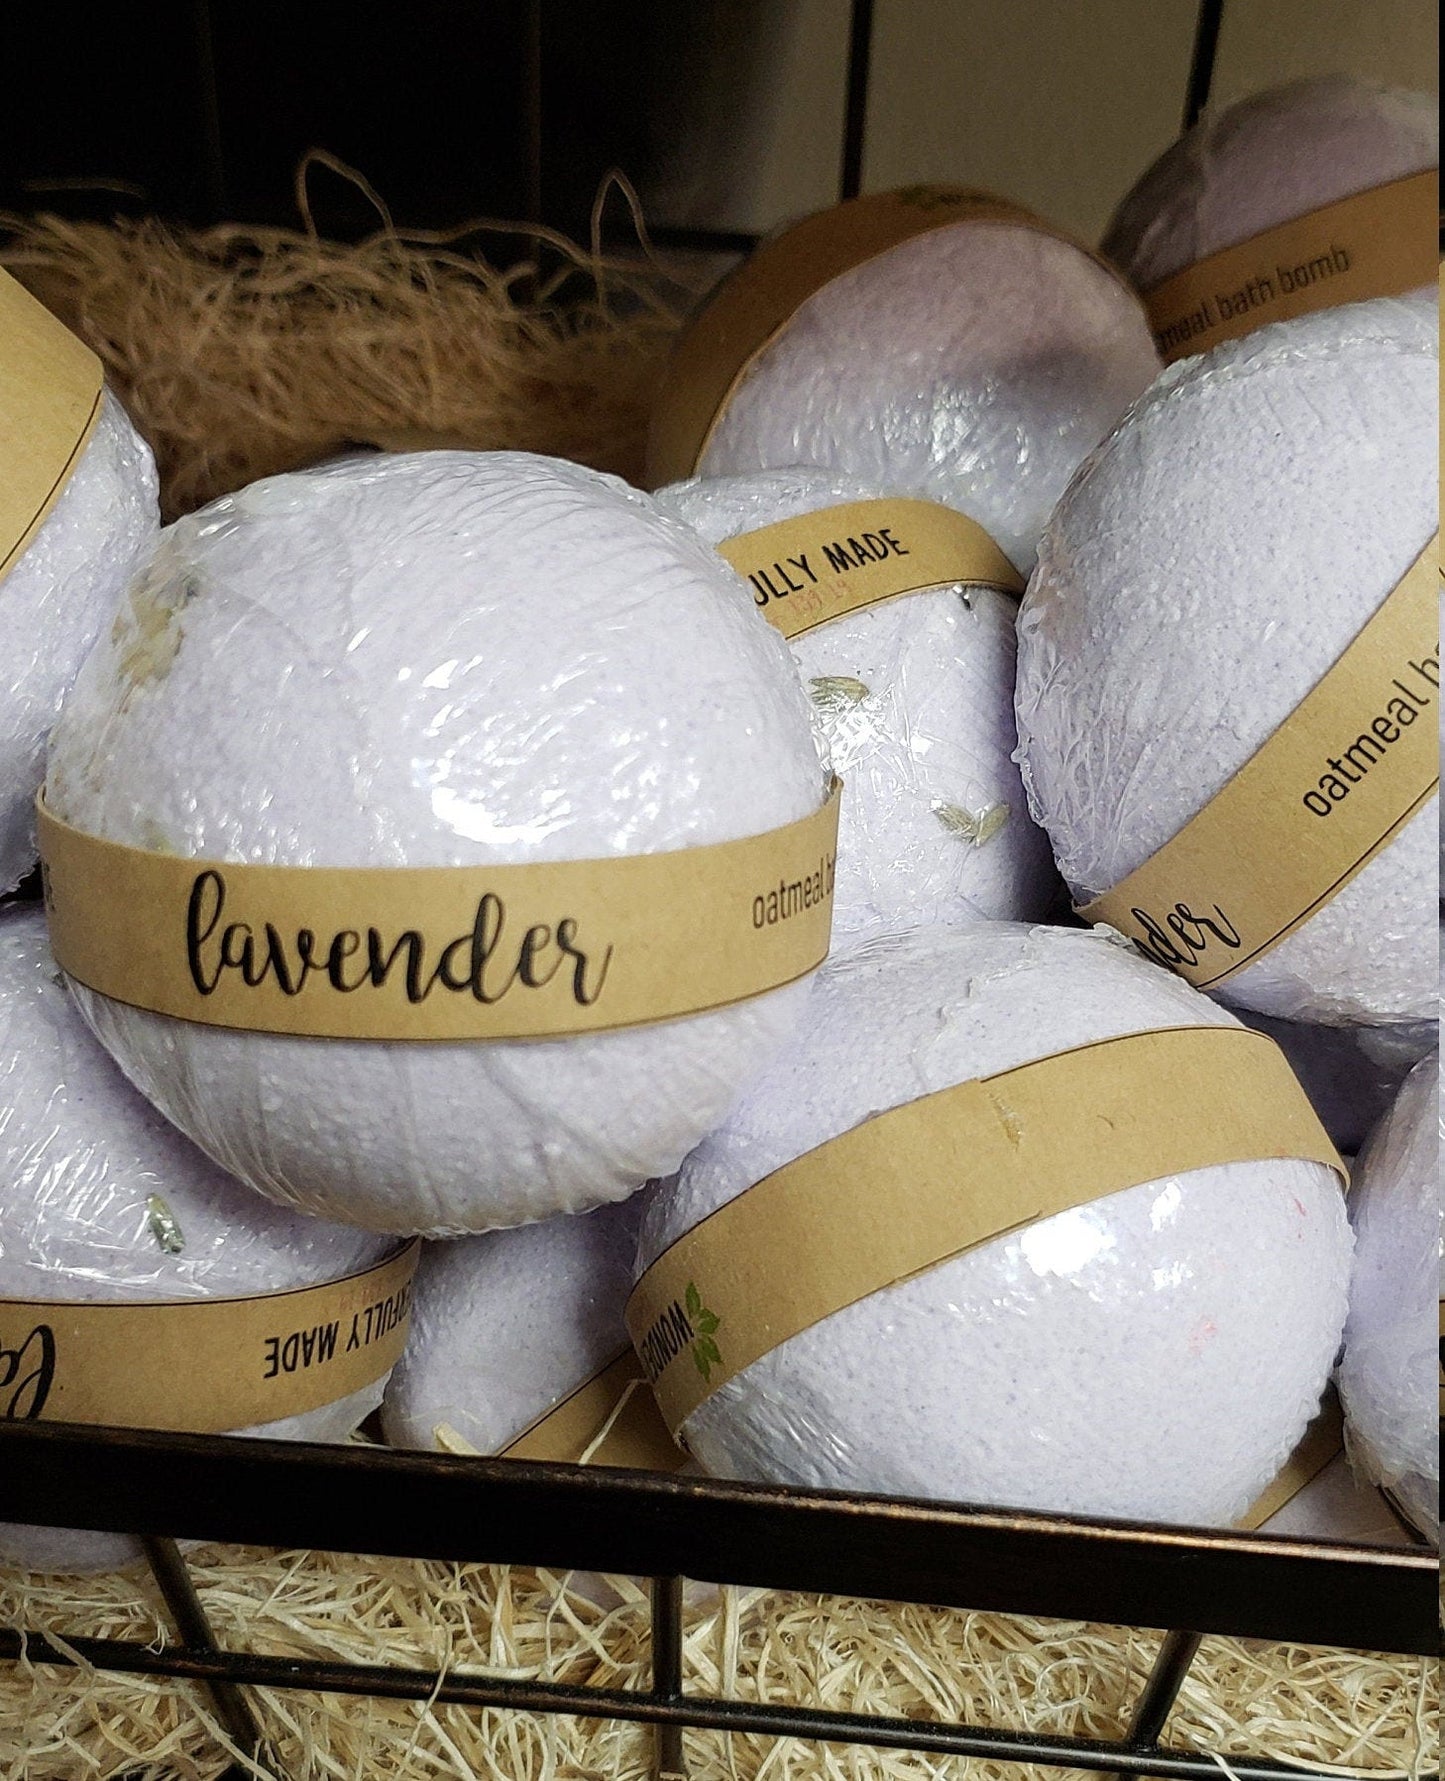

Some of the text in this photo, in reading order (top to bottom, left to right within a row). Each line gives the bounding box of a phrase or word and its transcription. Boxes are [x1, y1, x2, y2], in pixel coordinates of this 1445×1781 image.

[1215, 274, 1275, 321] bath
[1275, 244, 1350, 294] bomb
[821, 528, 911, 574] MADE
[1302, 678, 1431, 817] oatmeal
[752, 856, 824, 930] oatmeal
[186, 869, 614, 1007] lavender
[263, 1320, 340, 1380] MADE
